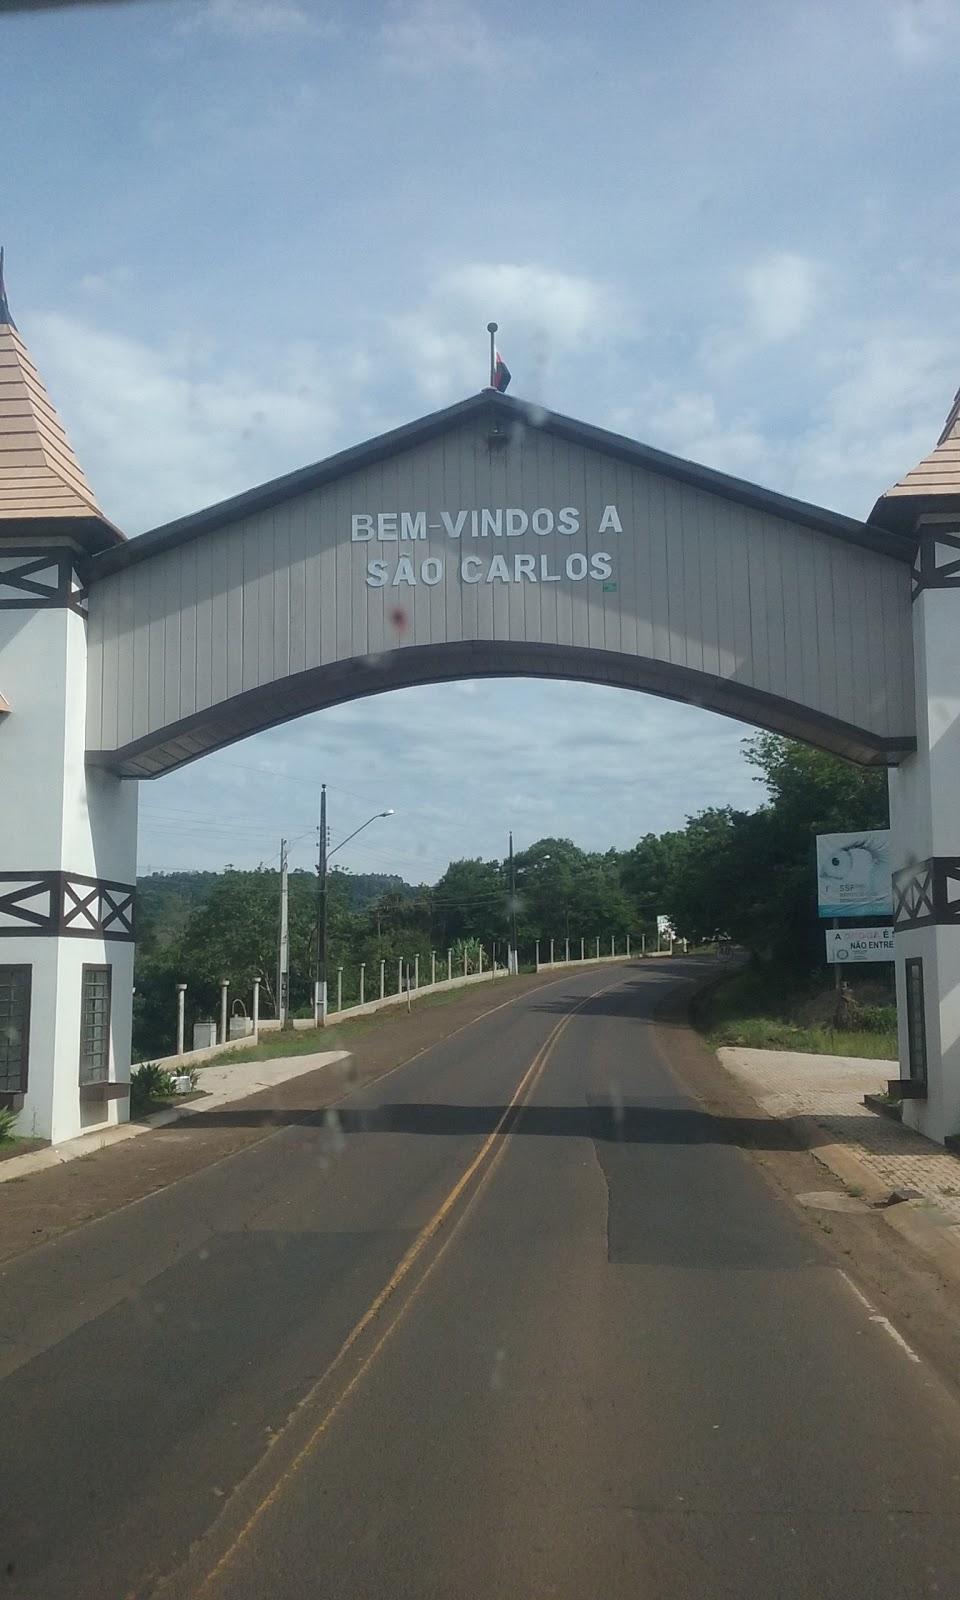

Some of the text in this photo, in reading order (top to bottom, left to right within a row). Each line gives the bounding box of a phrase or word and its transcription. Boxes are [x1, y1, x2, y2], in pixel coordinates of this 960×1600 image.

[351, 505, 623, 542] BEM-VINDOS A
[366, 552, 612, 587] SÃO CARLOS
[850, 940, 867, 949] NÃO
